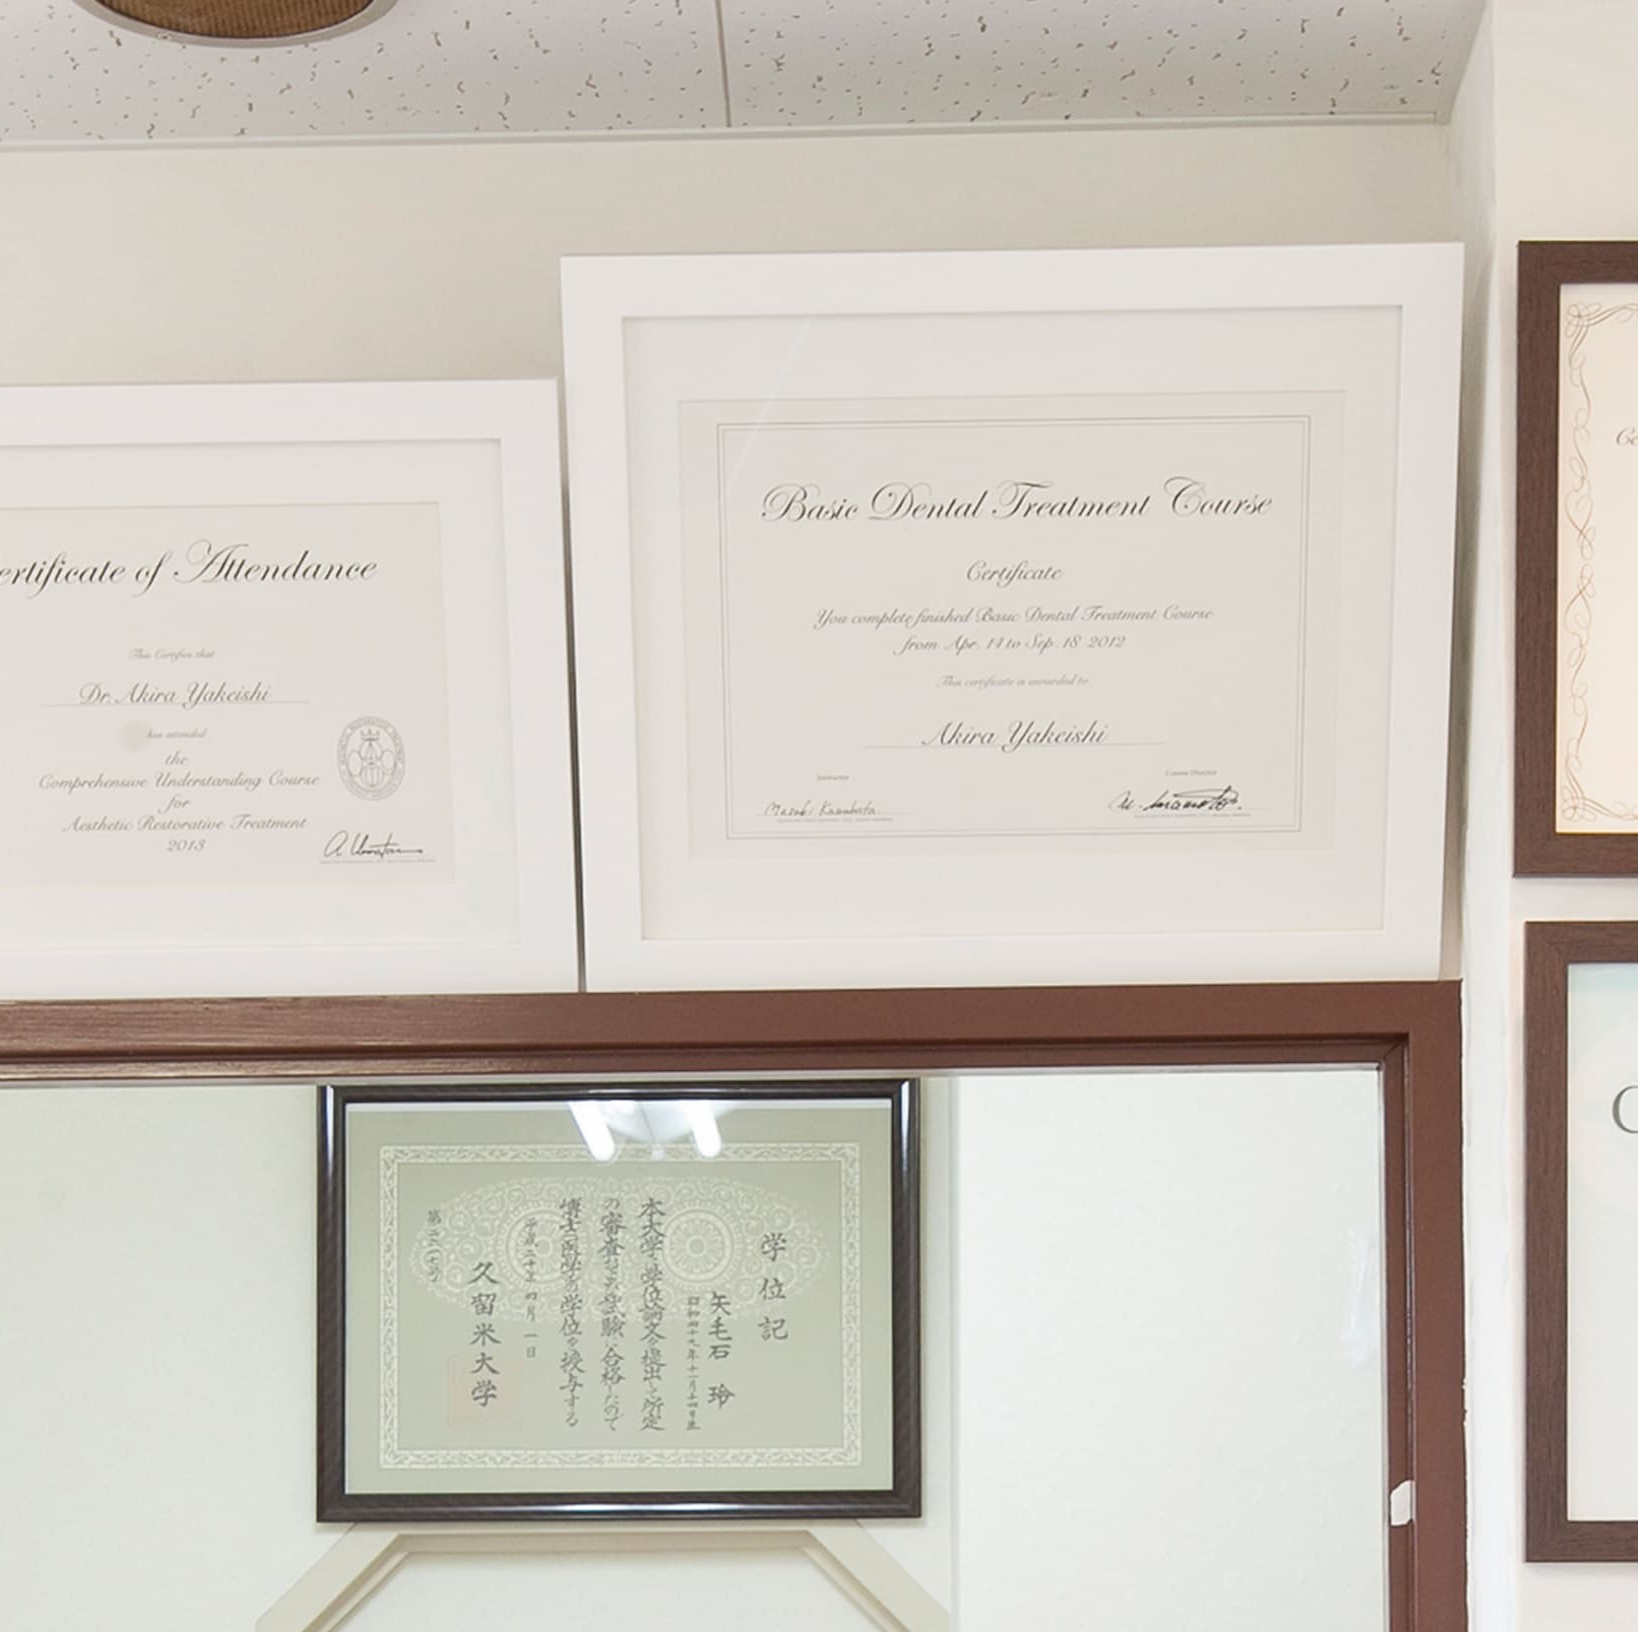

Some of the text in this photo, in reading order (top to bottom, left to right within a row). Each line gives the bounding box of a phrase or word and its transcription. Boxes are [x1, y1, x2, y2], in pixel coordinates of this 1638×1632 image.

[761, 476, 1272, 522] Basic Dental Treatment Course
[133, 551, 172, 598] of
[174, 539, 377, 584] Attendance
[965, 561, 1063, 589] Certificate
[813, 604, 1213, 630] You complete finished Basic Dental Treatment Course
[893, 634, 1125, 656] from 2012
[79, 681, 272, 710] Dr. Akira Yakeishi
[922, 719, 1108, 754] Akira Yakeishi
[165, 750, 189, 766] the
[39, 771, 320, 794] Comprehensive Understanding Course
[157, 794, 191, 814] for
[63, 814, 307, 832] Aesthetic Restorative Treatment
[758, 1232, 788, 1341] 学位記
[468, 1261, 501, 1407] 久留米大学
[709, 1292, 732, 1360] 矢毛石
